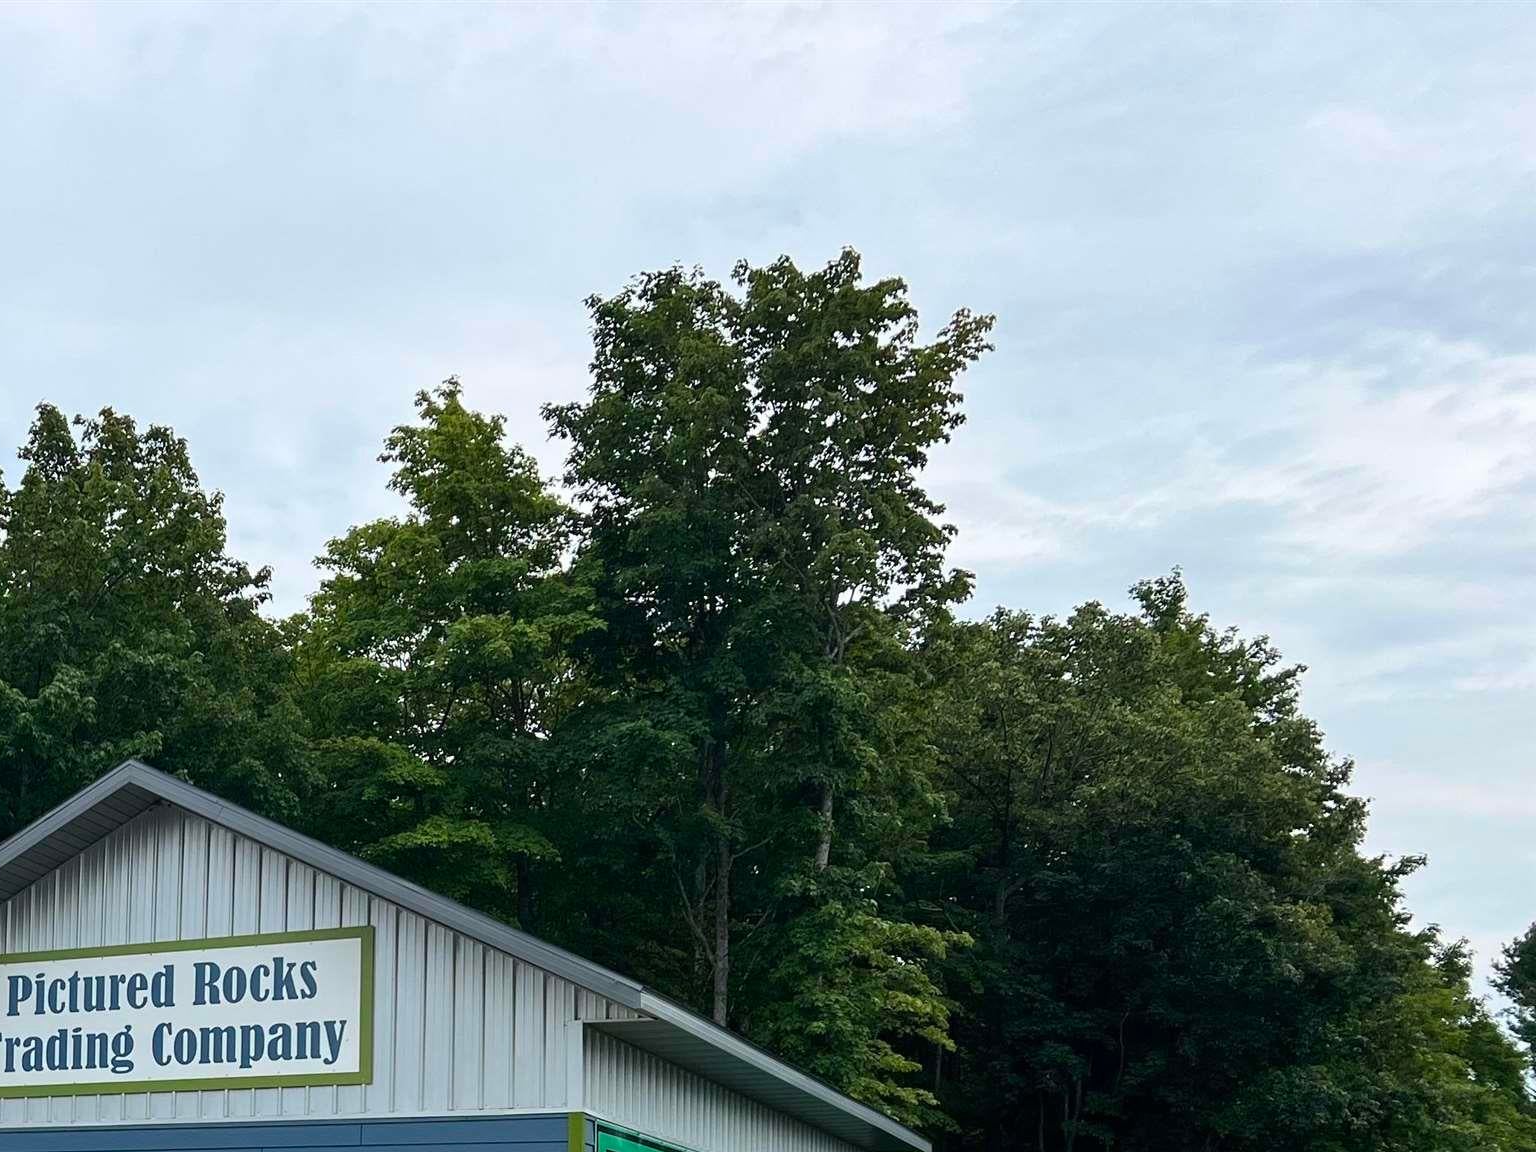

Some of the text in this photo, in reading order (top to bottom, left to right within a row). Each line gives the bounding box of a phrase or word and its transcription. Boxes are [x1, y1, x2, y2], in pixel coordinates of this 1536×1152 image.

[6, 956, 318, 1016] Pictured Rocks
[152, 1019, 348, 1069] Company
